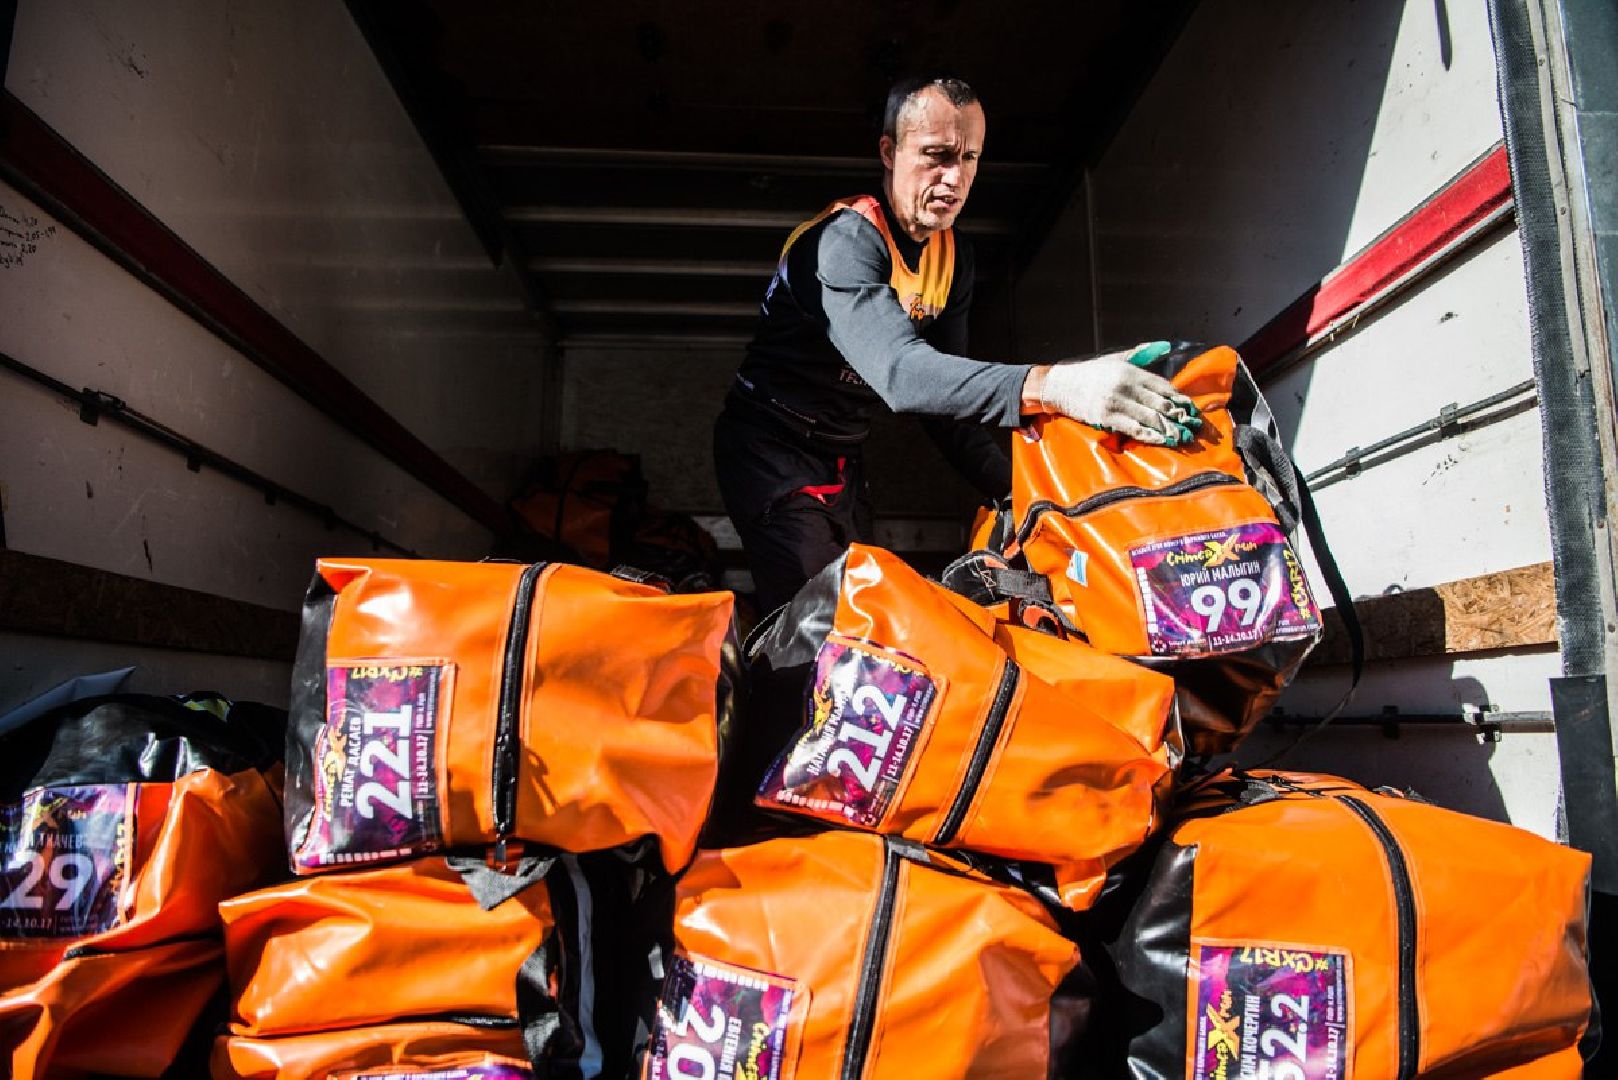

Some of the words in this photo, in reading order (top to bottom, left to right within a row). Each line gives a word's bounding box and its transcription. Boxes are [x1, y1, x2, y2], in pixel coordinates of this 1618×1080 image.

[1180, 568, 1211, 587] ЮРИЙ
[1212, 560, 1261, 582] МАЛЫГИН
[1190, 578, 1261, 633] 99
[339, 768, 356, 807] РЕНАТ
[348, 716, 362, 766] ДАСАЕВ
[356, 704, 413, 819] 221
[827, 685, 908, 792] 212
[0, 851, 94, 911] 29
[1243, 994, 1260, 1051] КОЧЕРГИН
